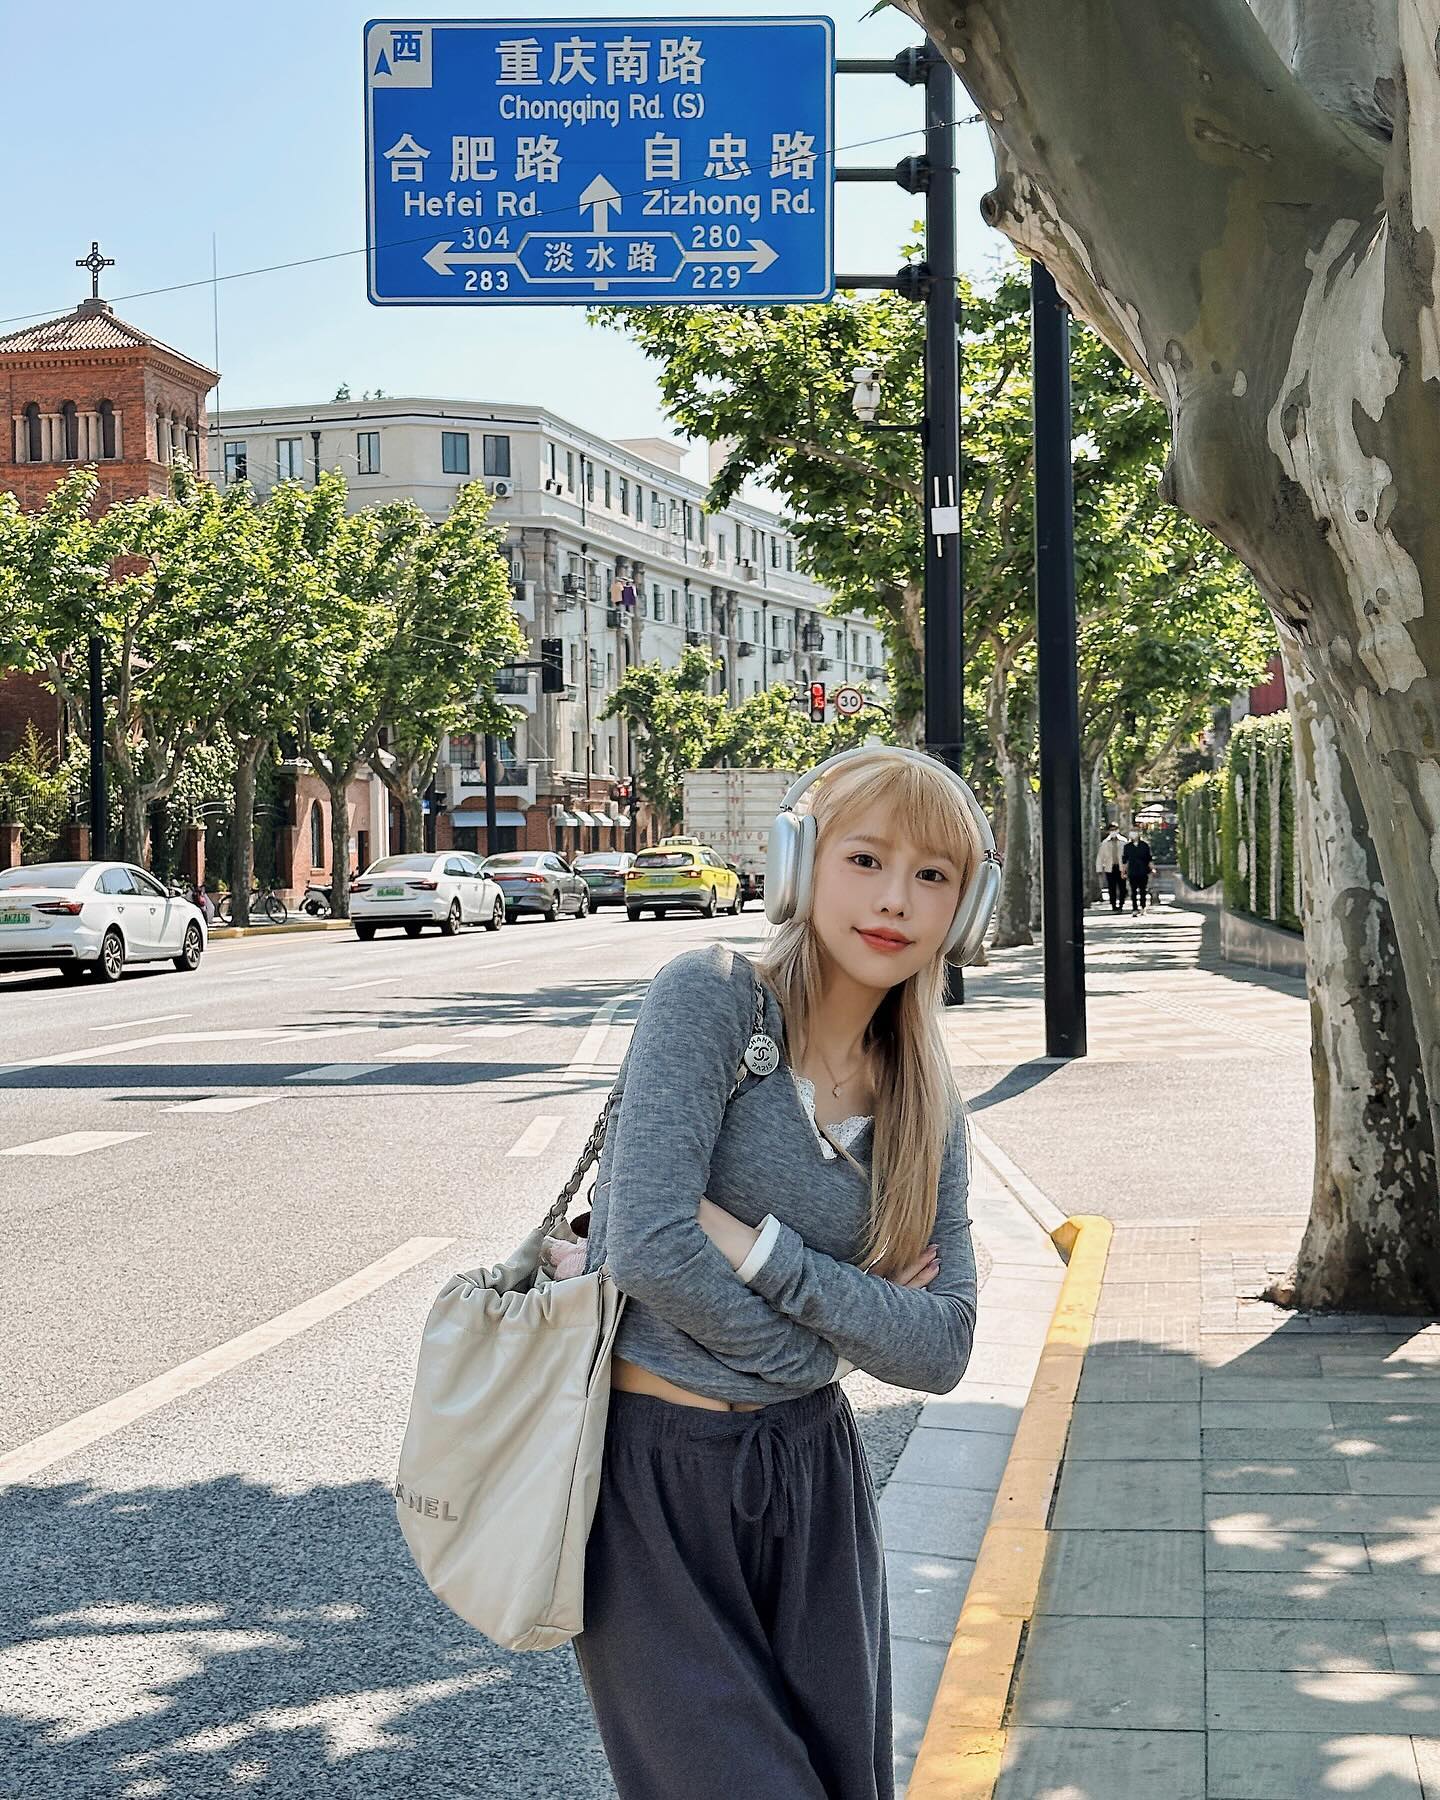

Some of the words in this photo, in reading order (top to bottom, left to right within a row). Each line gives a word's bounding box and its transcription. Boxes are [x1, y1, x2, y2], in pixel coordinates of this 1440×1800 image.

[389, 30, 423, 63] 西
[495, 36, 706, 86] 重庆南路
[499, 94, 620, 128] Chongqing
[629, 94, 665, 119] Rd.
[673, 94, 706, 119] (S)
[383, 133, 563, 183] 合肥路
[644, 131, 819, 181] 自忠路
[404, 191, 482, 217] Hefei
[497, 191, 543, 217] Rd.
[642, 188, 761, 221] Zizhong
[771, 189, 816, 214] Rd.
[461, 226, 510, 250] 304
[691, 225, 741, 248] 280
[543, 241, 657, 273] 淡水路
[464, 270, 509, 291] 283
[691, 265, 741, 289] 229
[841, 695, 858, 707] 30
[751, 1062, 773, 1072] PARIS
